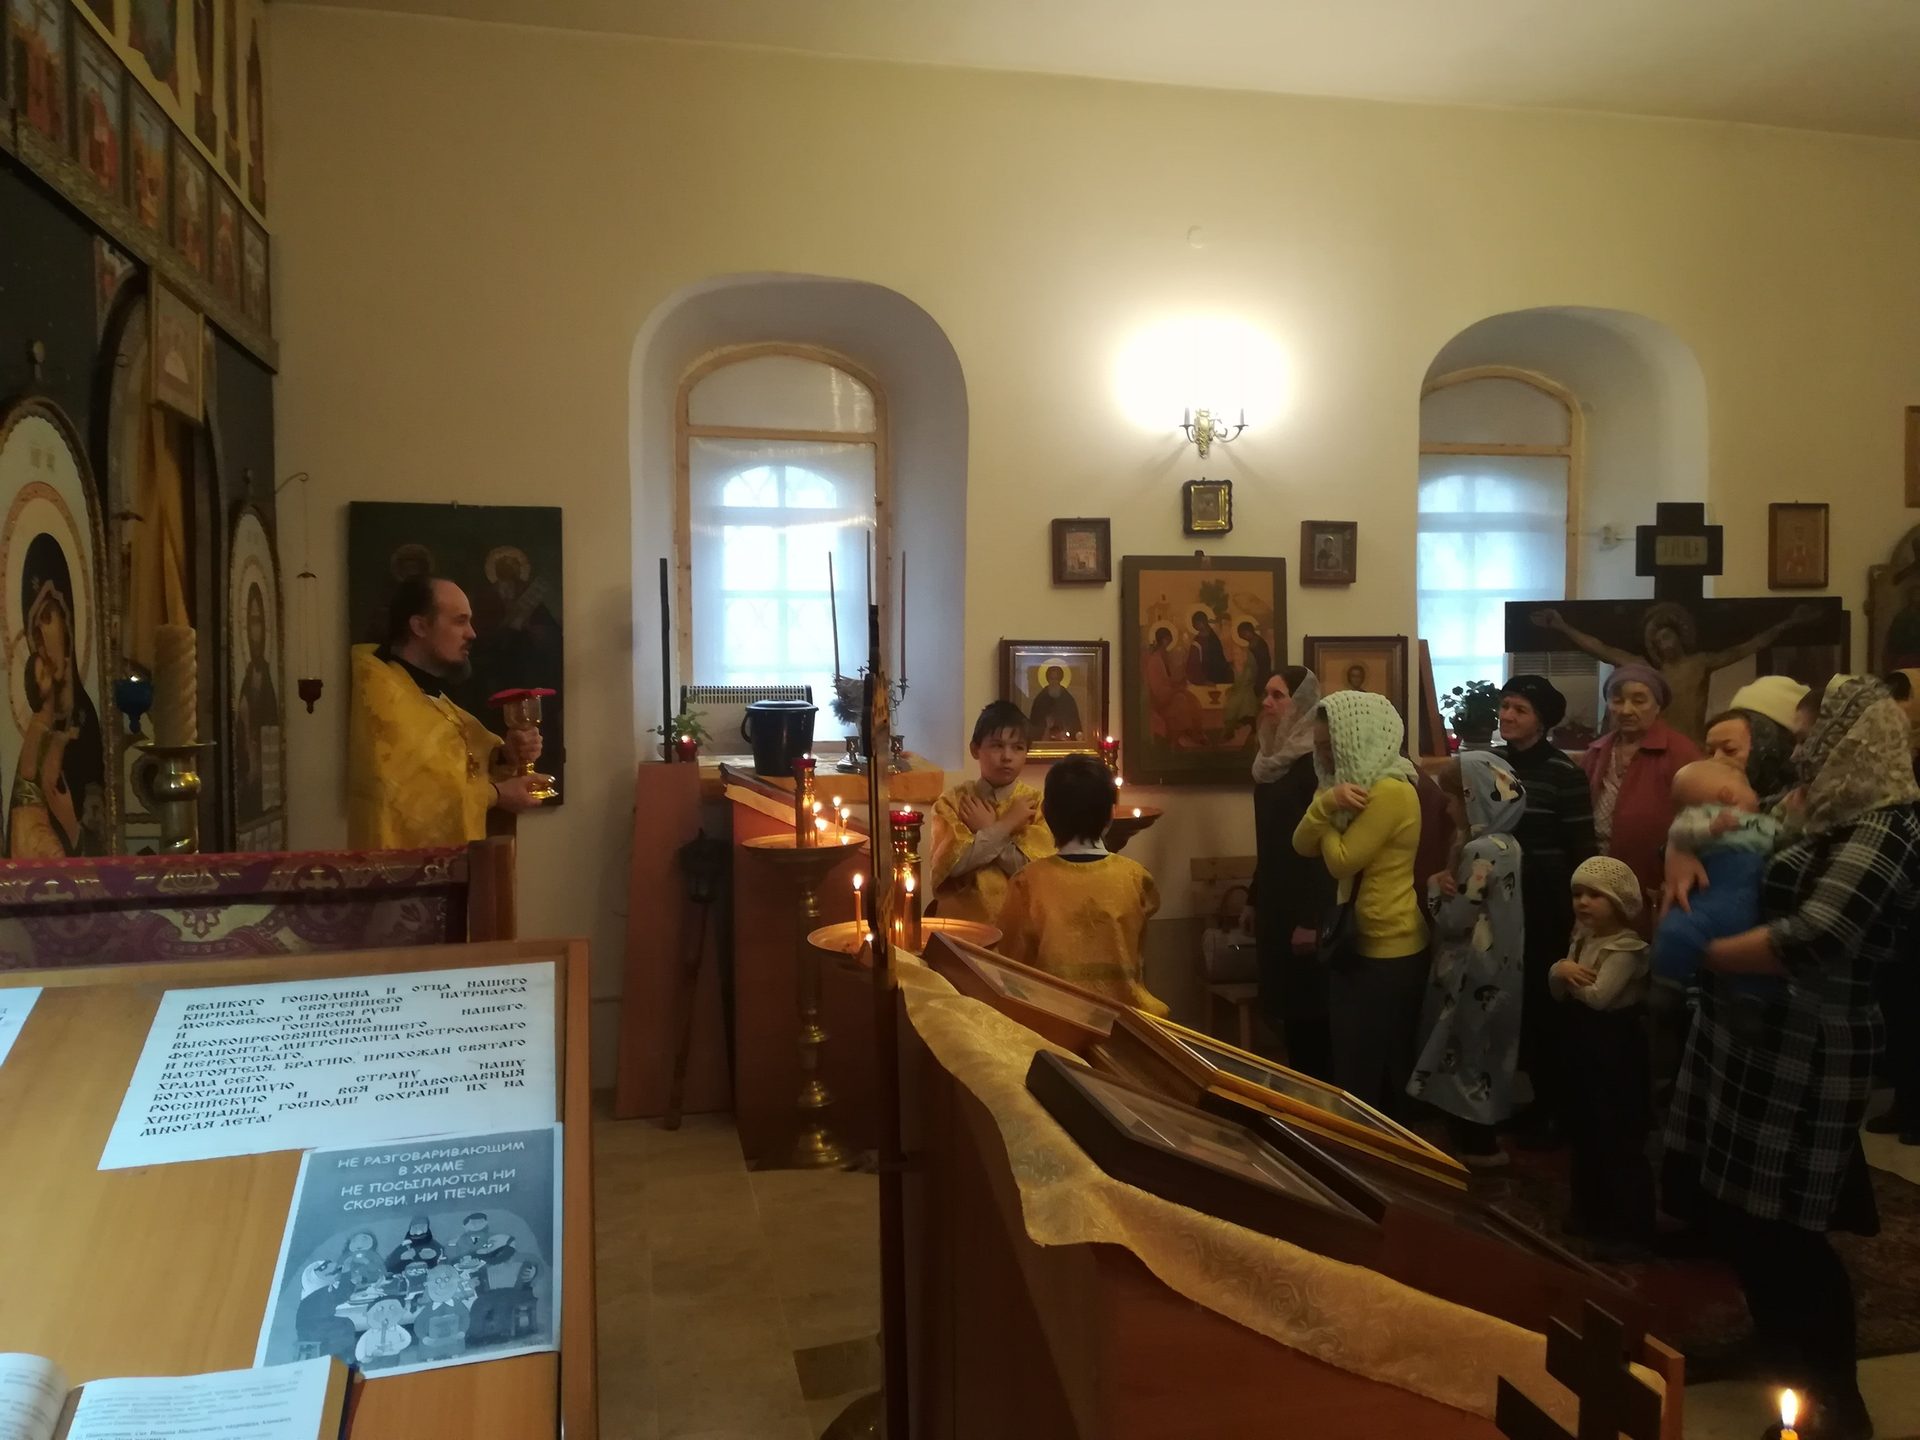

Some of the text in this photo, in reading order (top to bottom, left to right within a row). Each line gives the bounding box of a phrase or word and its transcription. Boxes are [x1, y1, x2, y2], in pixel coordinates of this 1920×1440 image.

[185, 977, 528, 1012] ВЕЛИКОГО ГОСПОДИНА И ОТЦА НАШЕГО
[298, 996, 404, 1012] СВЯТЕЙШЕГО
[440, 986, 527, 999] ПАТРИАРХА
[175, 1032, 187, 1040] И
[281, 1017, 372, 1031] ГОСПОДИНА
[177, 1005, 401, 1030] МОСКОВСКОГО И ВСЕЯ РУСИ
[172, 1020, 428, 1050] ВЫСОКОПРЕОСВЯЩЕННЕЙШЕГО
[279, 1034, 401, 1051] МИТРОПОЛИТА
[406, 1021, 526, 1040] КОСТРОМСКАГО
[363, 1046, 451, 1062] ПРИХОЖАН
[458, 1039, 526, 1053] СВЯТАГО
[165, 1062, 177, 1070] И
[153, 1059, 526, 1101] БОГОХРАНИМУЮ СТРАНУ НАШУ
[157, 1079, 217, 1090] ХРАМА
[297, 1091, 308, 1099] И
[337, 1085, 369, 1095] ВСЯ
[398, 1068, 525, 1089] ПРАВОСЛАВНЫЯ
[278, 1096, 359, 1111] ГОСПОДИ!
[375, 1086, 450, 1102] СОХРАНИ
[466, 1083, 488, 1092] ИХ
[504, 1079, 525, 1088] НА
[139, 1114, 273, 1137] МНОГАЯ ЛЕТА!
[337, 1141, 526, 1169] НЕ РАЗГОВАРИВАЮЩИМ
[398, 1159, 465, 1176] В ХРАМЕ
[341, 1168, 517, 1197] НЕ ПОСЫЛАЮТСЯ НИ
[414, 1191, 439, 1204] НИ
[444, 1183, 511, 1200] ПЕЧАЛИ
